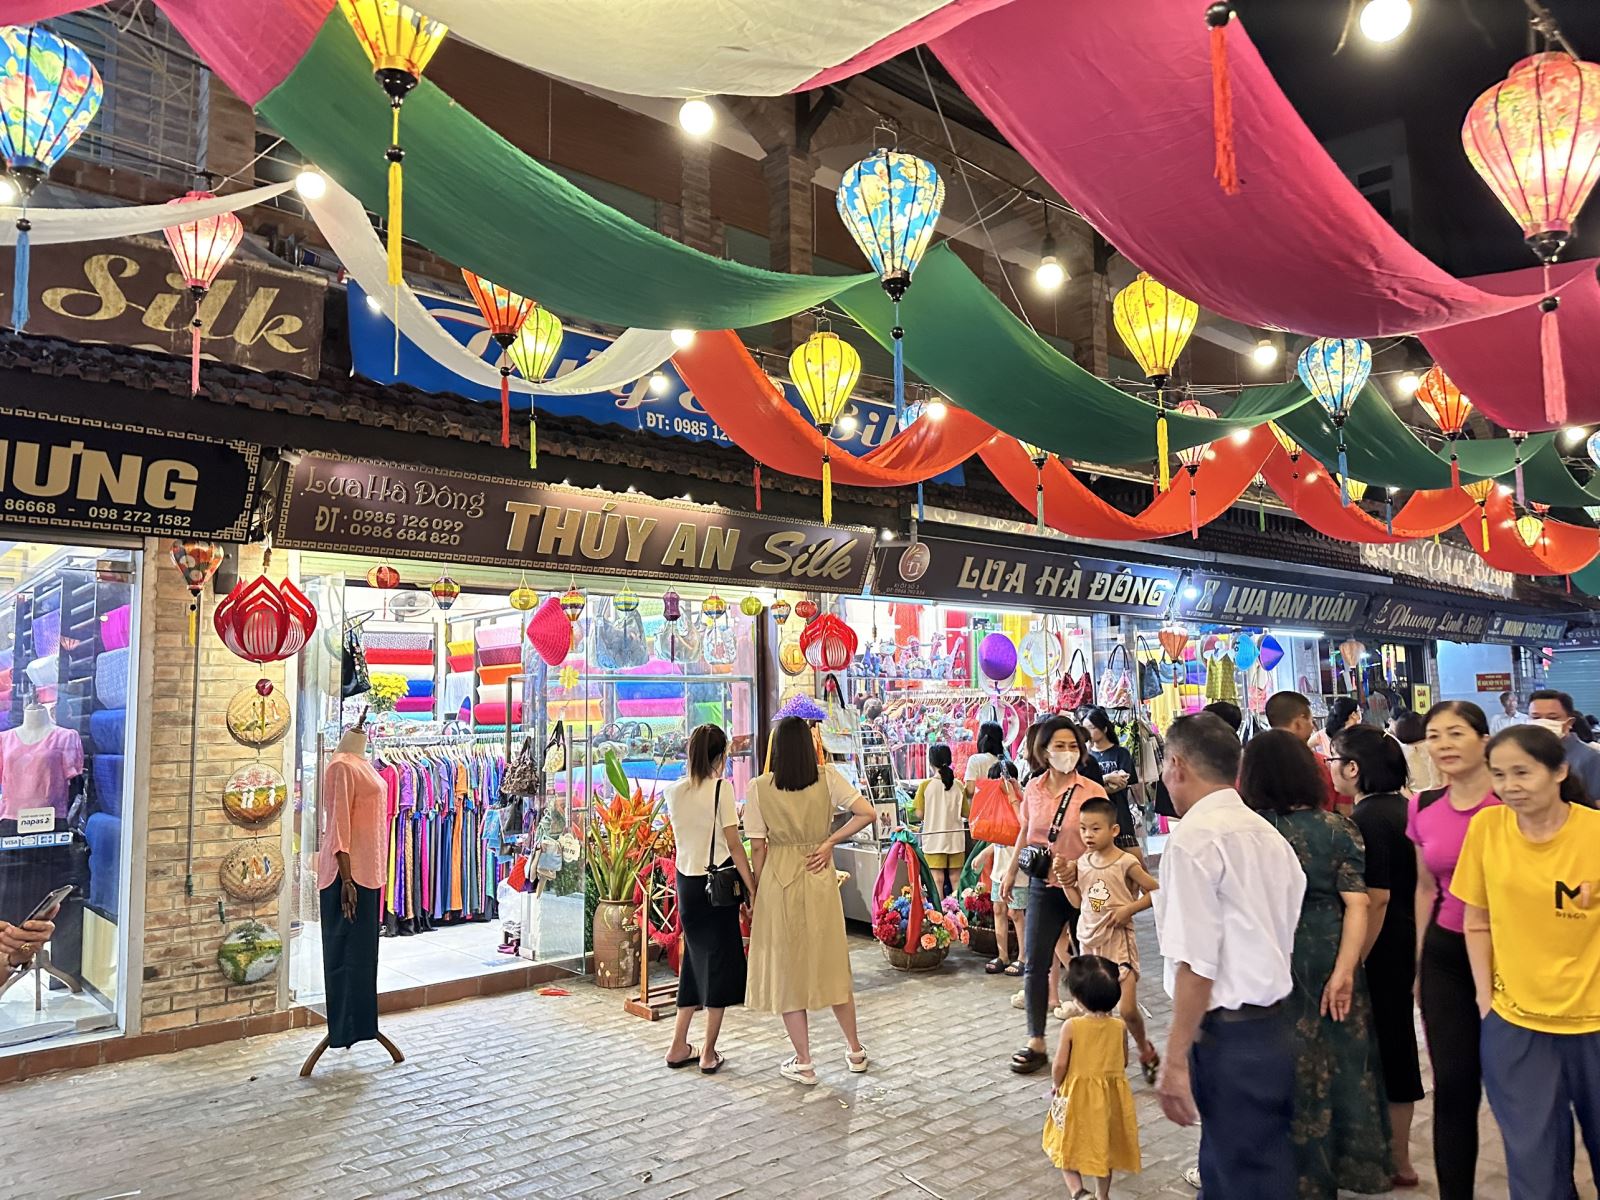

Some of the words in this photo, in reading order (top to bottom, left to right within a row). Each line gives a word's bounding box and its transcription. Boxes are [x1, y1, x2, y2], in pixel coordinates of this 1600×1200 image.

[42, 254, 309, 353] Silk
[646, 412, 670, 430] ĐT:
[673, 417, 708, 437] 0985
[712, 424, 733, 442] 12
[4, 499, 57, 514] 86668
[88, 506, 118, 520] 098
[123, 510, 152, 523] 272
[157, 514, 191, 527] 1582
[414, 480, 485, 518] Đông
[350, 523, 393, 539] 0986
[396, 529, 427, 544] 684
[430, 533, 461, 546] 820
[352, 509, 396, 525] 0985
[402, 514, 429, 529] 126
[432, 518, 464, 533] 099
[505, 501, 657, 563] THÚY
[661, 522, 740, 571] AN
[750, 531, 858, 580] Silk
[957, 556, 1028, 598] LỤA
[1035, 560, 1083, 600] HÀ
[1087, 568, 1170, 606] ĐÔNG
[1304, 592, 1358, 622] XUÂN
[1463, 615, 1483, 635] Silk
[1501, 620, 1525, 636] MINH
[1544, 625, 1563, 639] SILK
